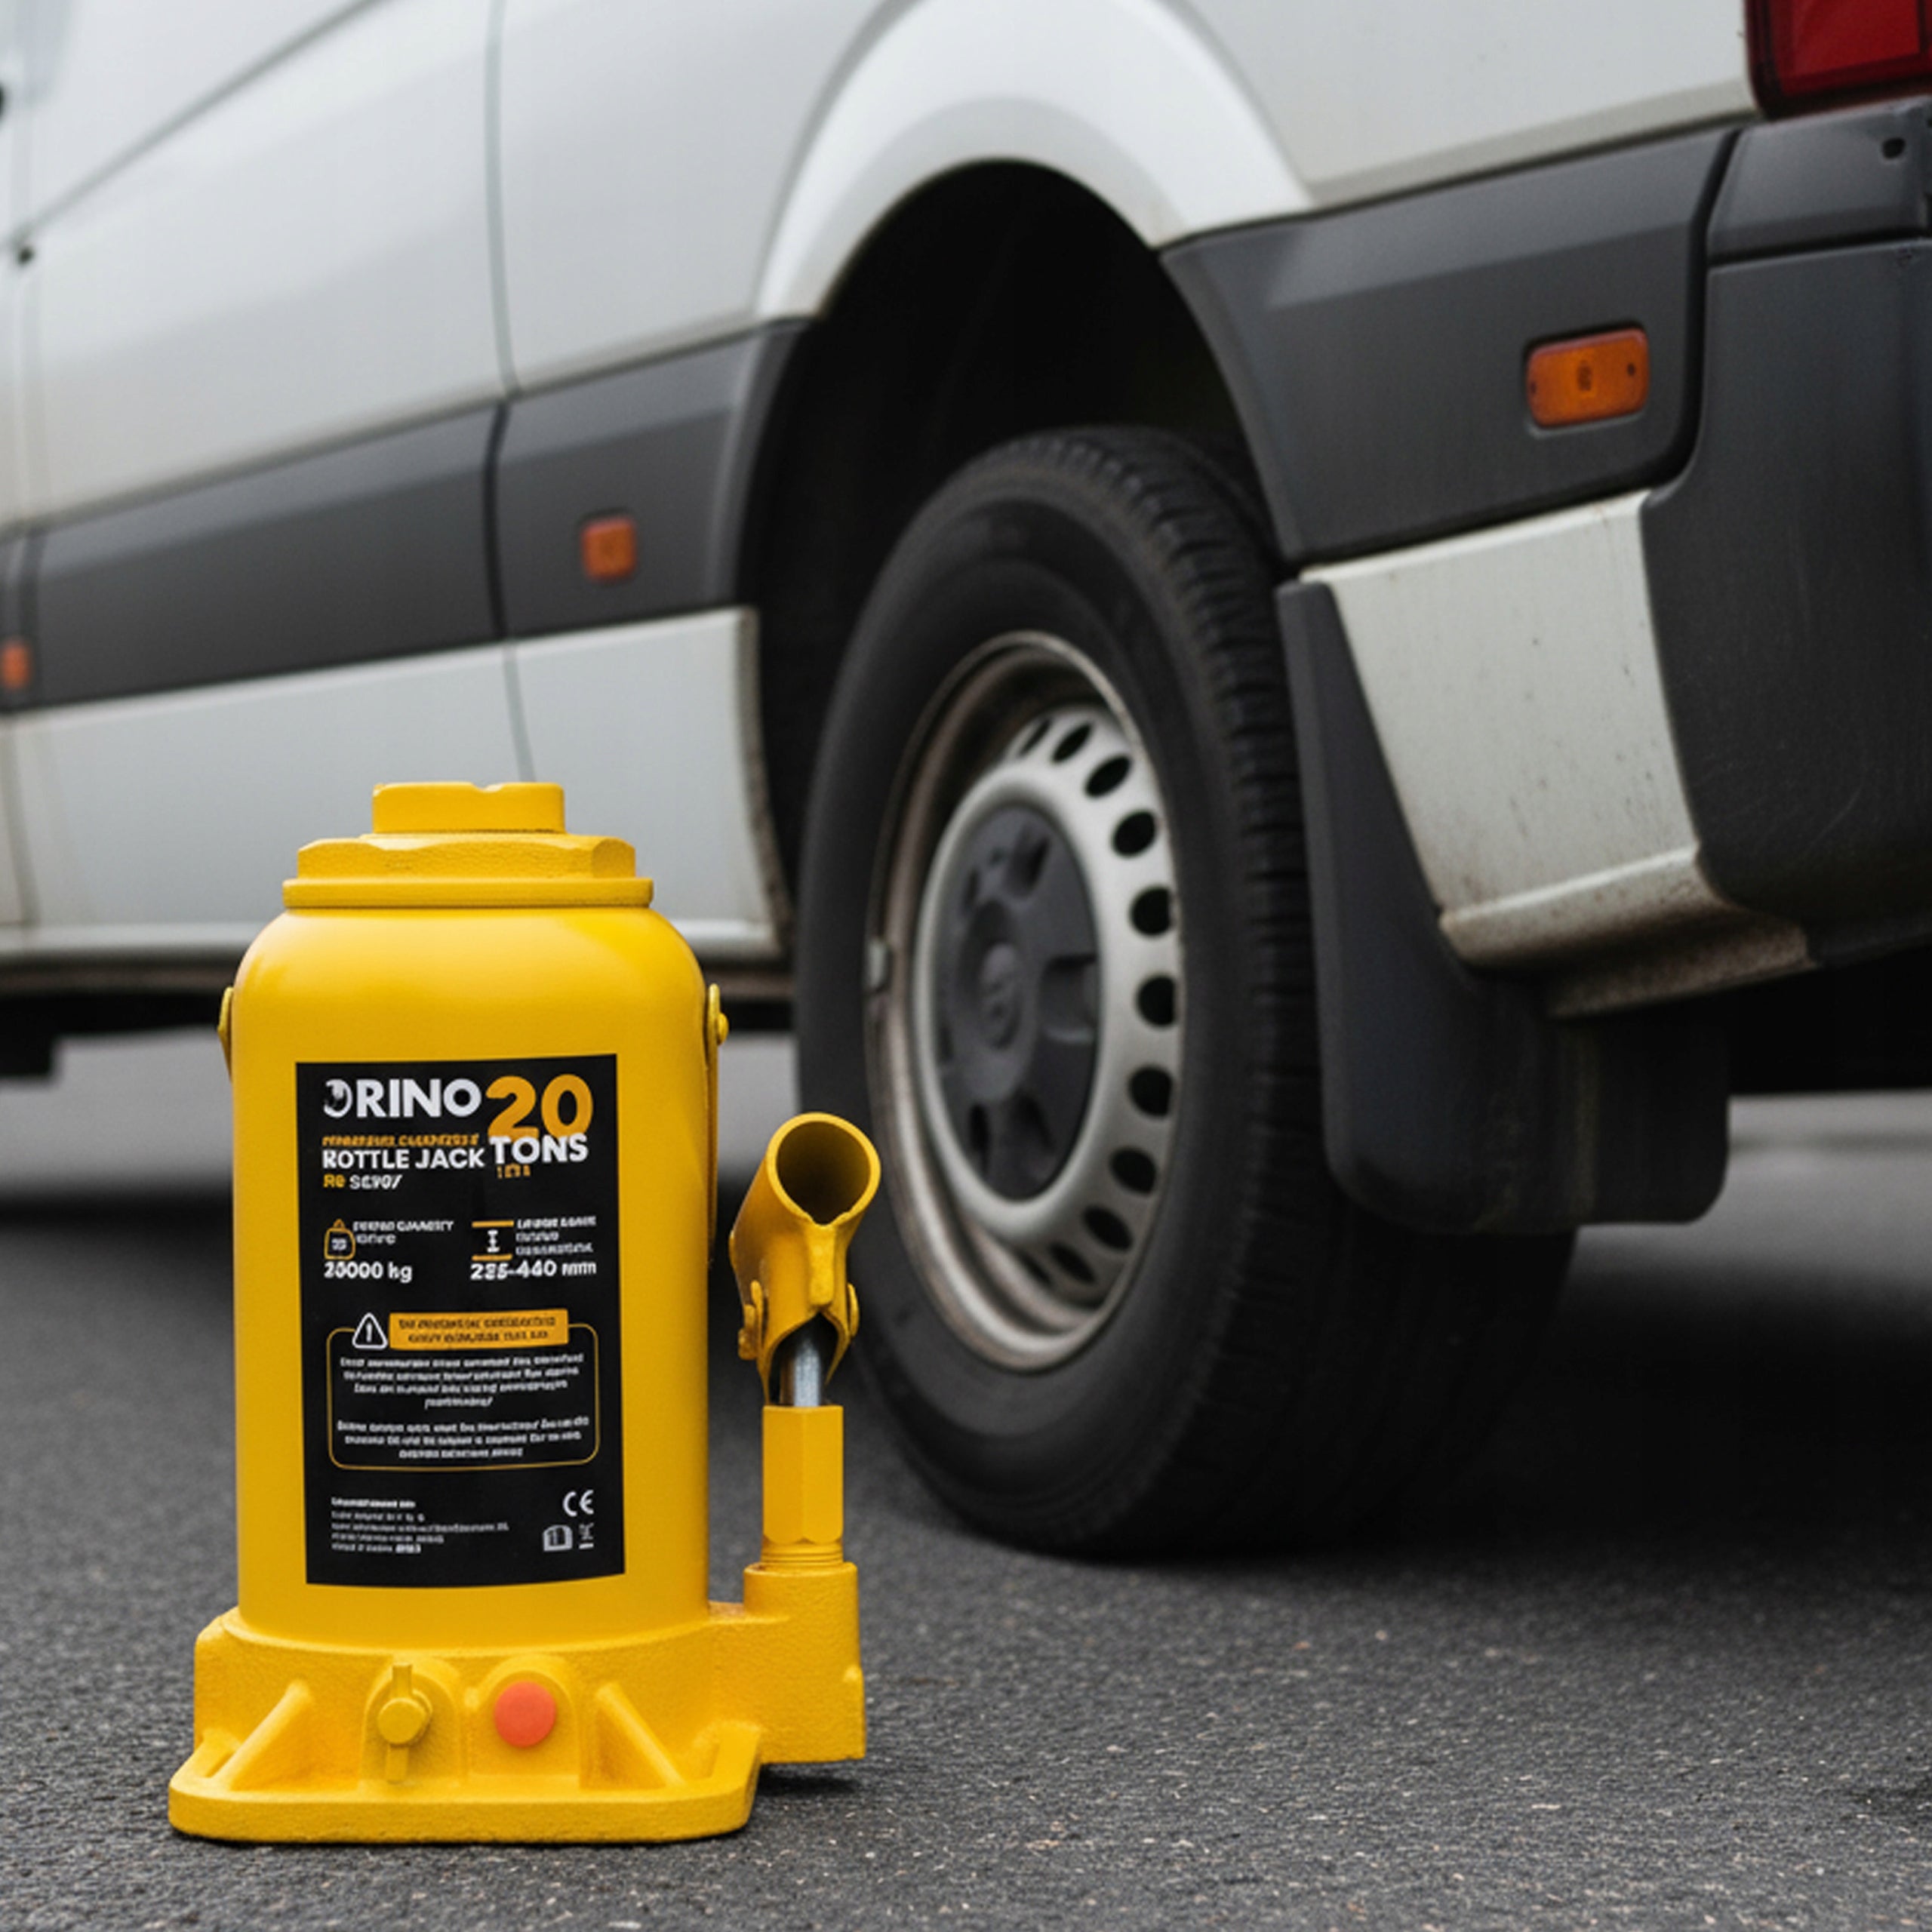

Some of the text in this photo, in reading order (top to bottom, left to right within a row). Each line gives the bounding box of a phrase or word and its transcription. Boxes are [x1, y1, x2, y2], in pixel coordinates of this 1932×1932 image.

[485, 1074, 593, 1141] 20
[414, 1148, 485, 1169] JACK
[488, 1132, 589, 1164] TONS
